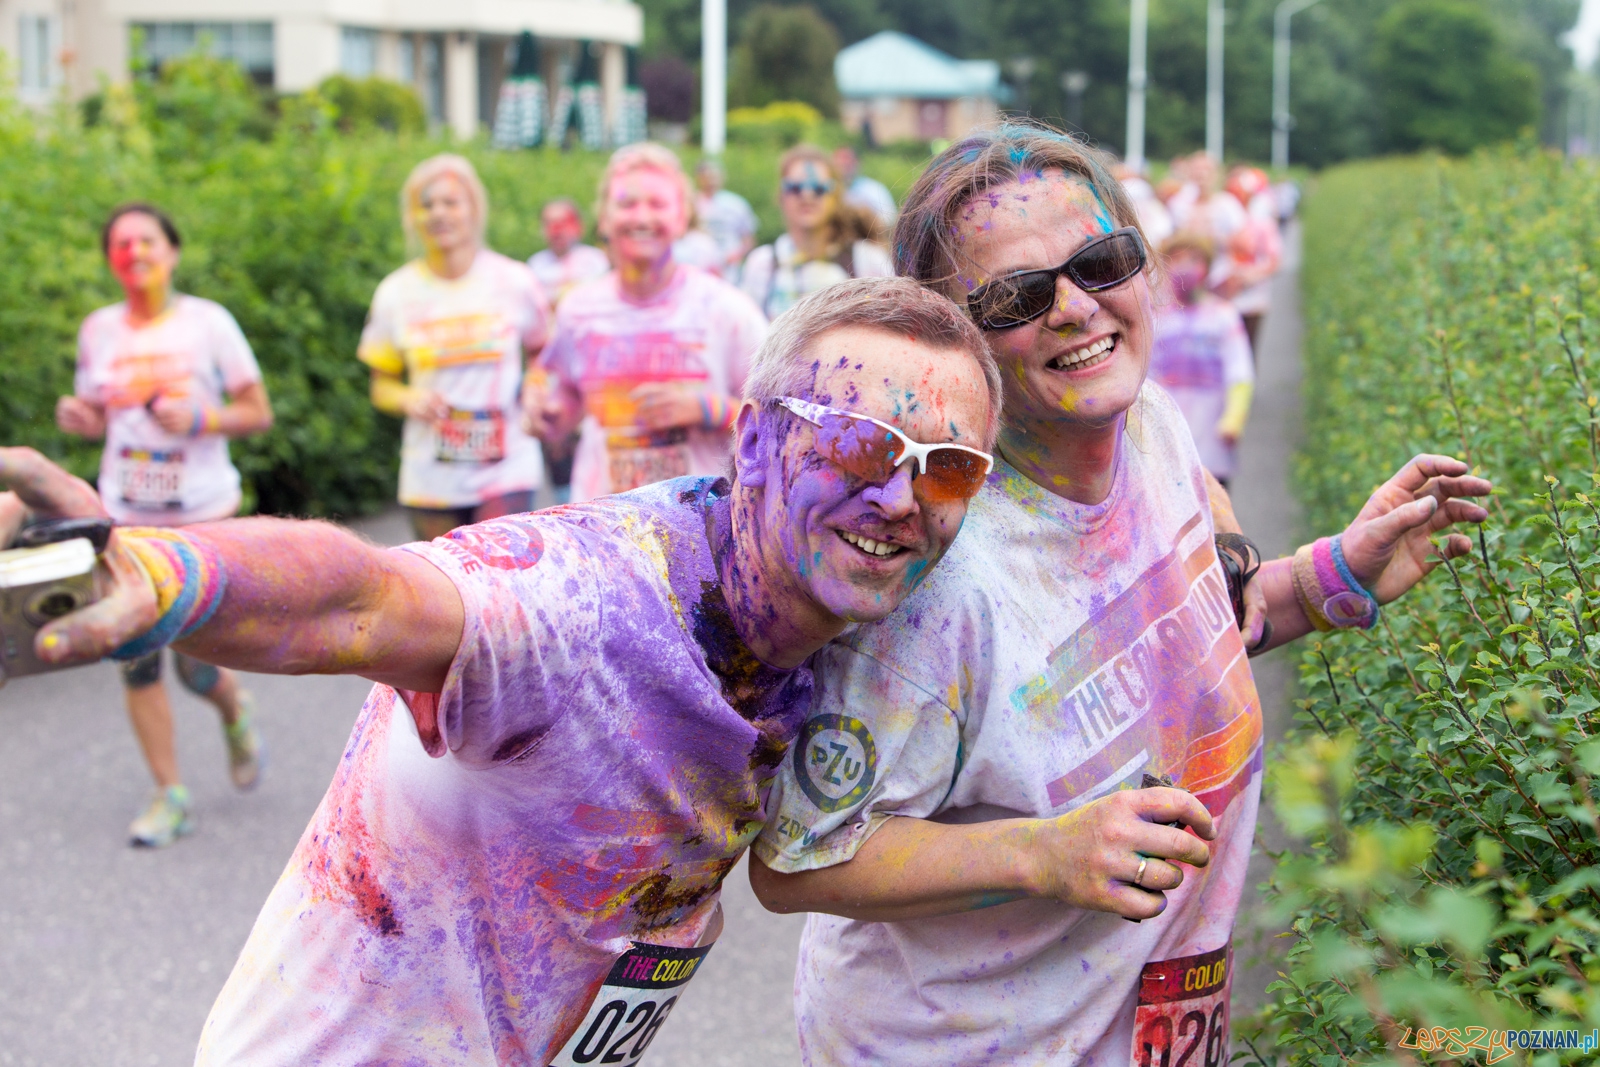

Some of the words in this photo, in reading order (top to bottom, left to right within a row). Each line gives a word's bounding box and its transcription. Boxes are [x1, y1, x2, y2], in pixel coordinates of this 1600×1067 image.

[1063, 670, 1130, 750] THE
[811, 741, 862, 787] PZU
[1184, 957, 1227, 992] COLOR
